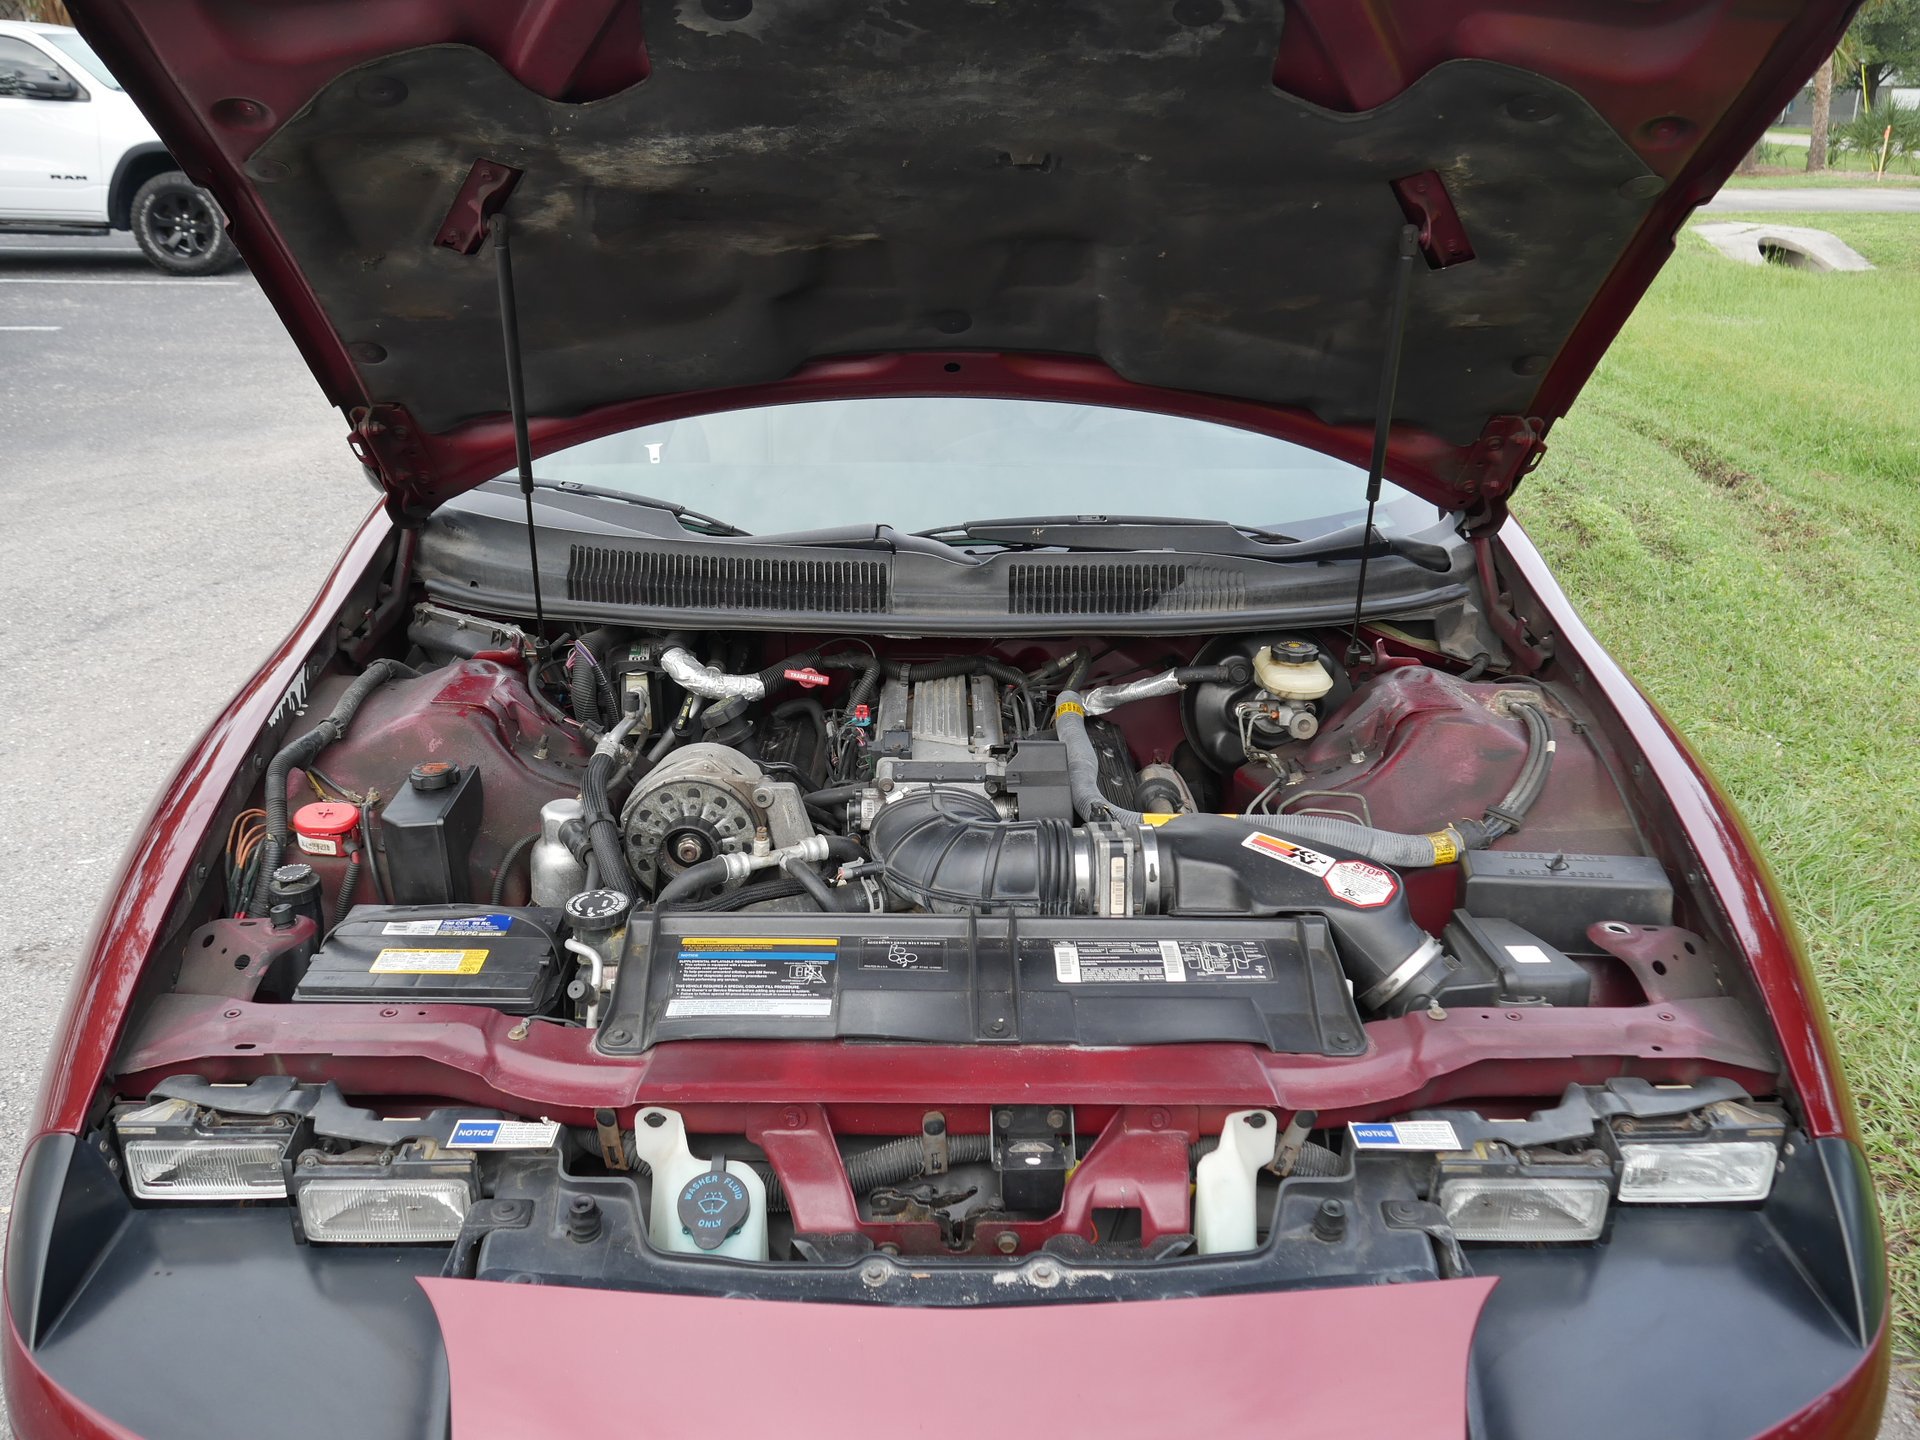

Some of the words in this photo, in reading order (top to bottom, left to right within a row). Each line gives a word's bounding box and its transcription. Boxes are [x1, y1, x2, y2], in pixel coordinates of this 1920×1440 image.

[790, 672, 808, 680] TRANS
[1353, 862, 1383, 877] STOP
[458, 1129, 495, 1137] NOTICE
[1357, 1129, 1394, 1137] NOTICE
[684, 1175, 718, 1200] WASHER
[724, 1177, 743, 1200] FLUID
[698, 1218, 722, 1228] ONLY
